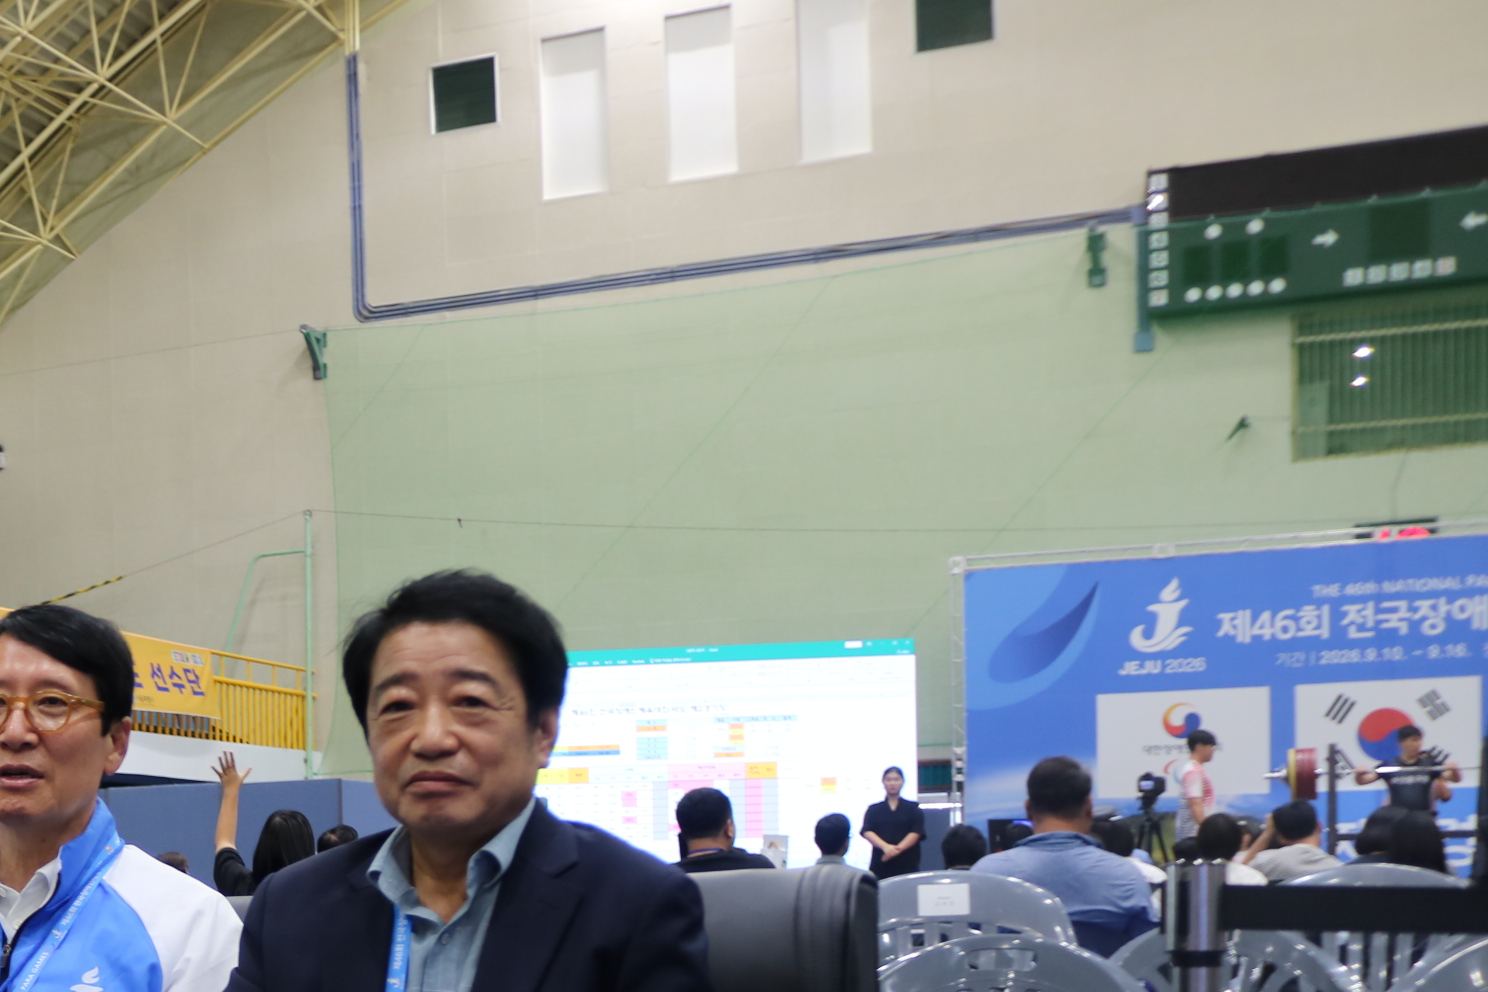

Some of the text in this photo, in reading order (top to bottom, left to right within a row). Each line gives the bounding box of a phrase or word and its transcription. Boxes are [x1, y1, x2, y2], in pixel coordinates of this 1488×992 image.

[1380, 576, 1461, 594] NATIONAL
[1216, 593, 1488, 645] 제46회 전국장애
[150, 662, 206, 697] 선수단
[1118, 657, 1207, 676] JEJU 2026
[21, 973, 36, 992] PARA
[32, 951, 50, 975] GAMES
